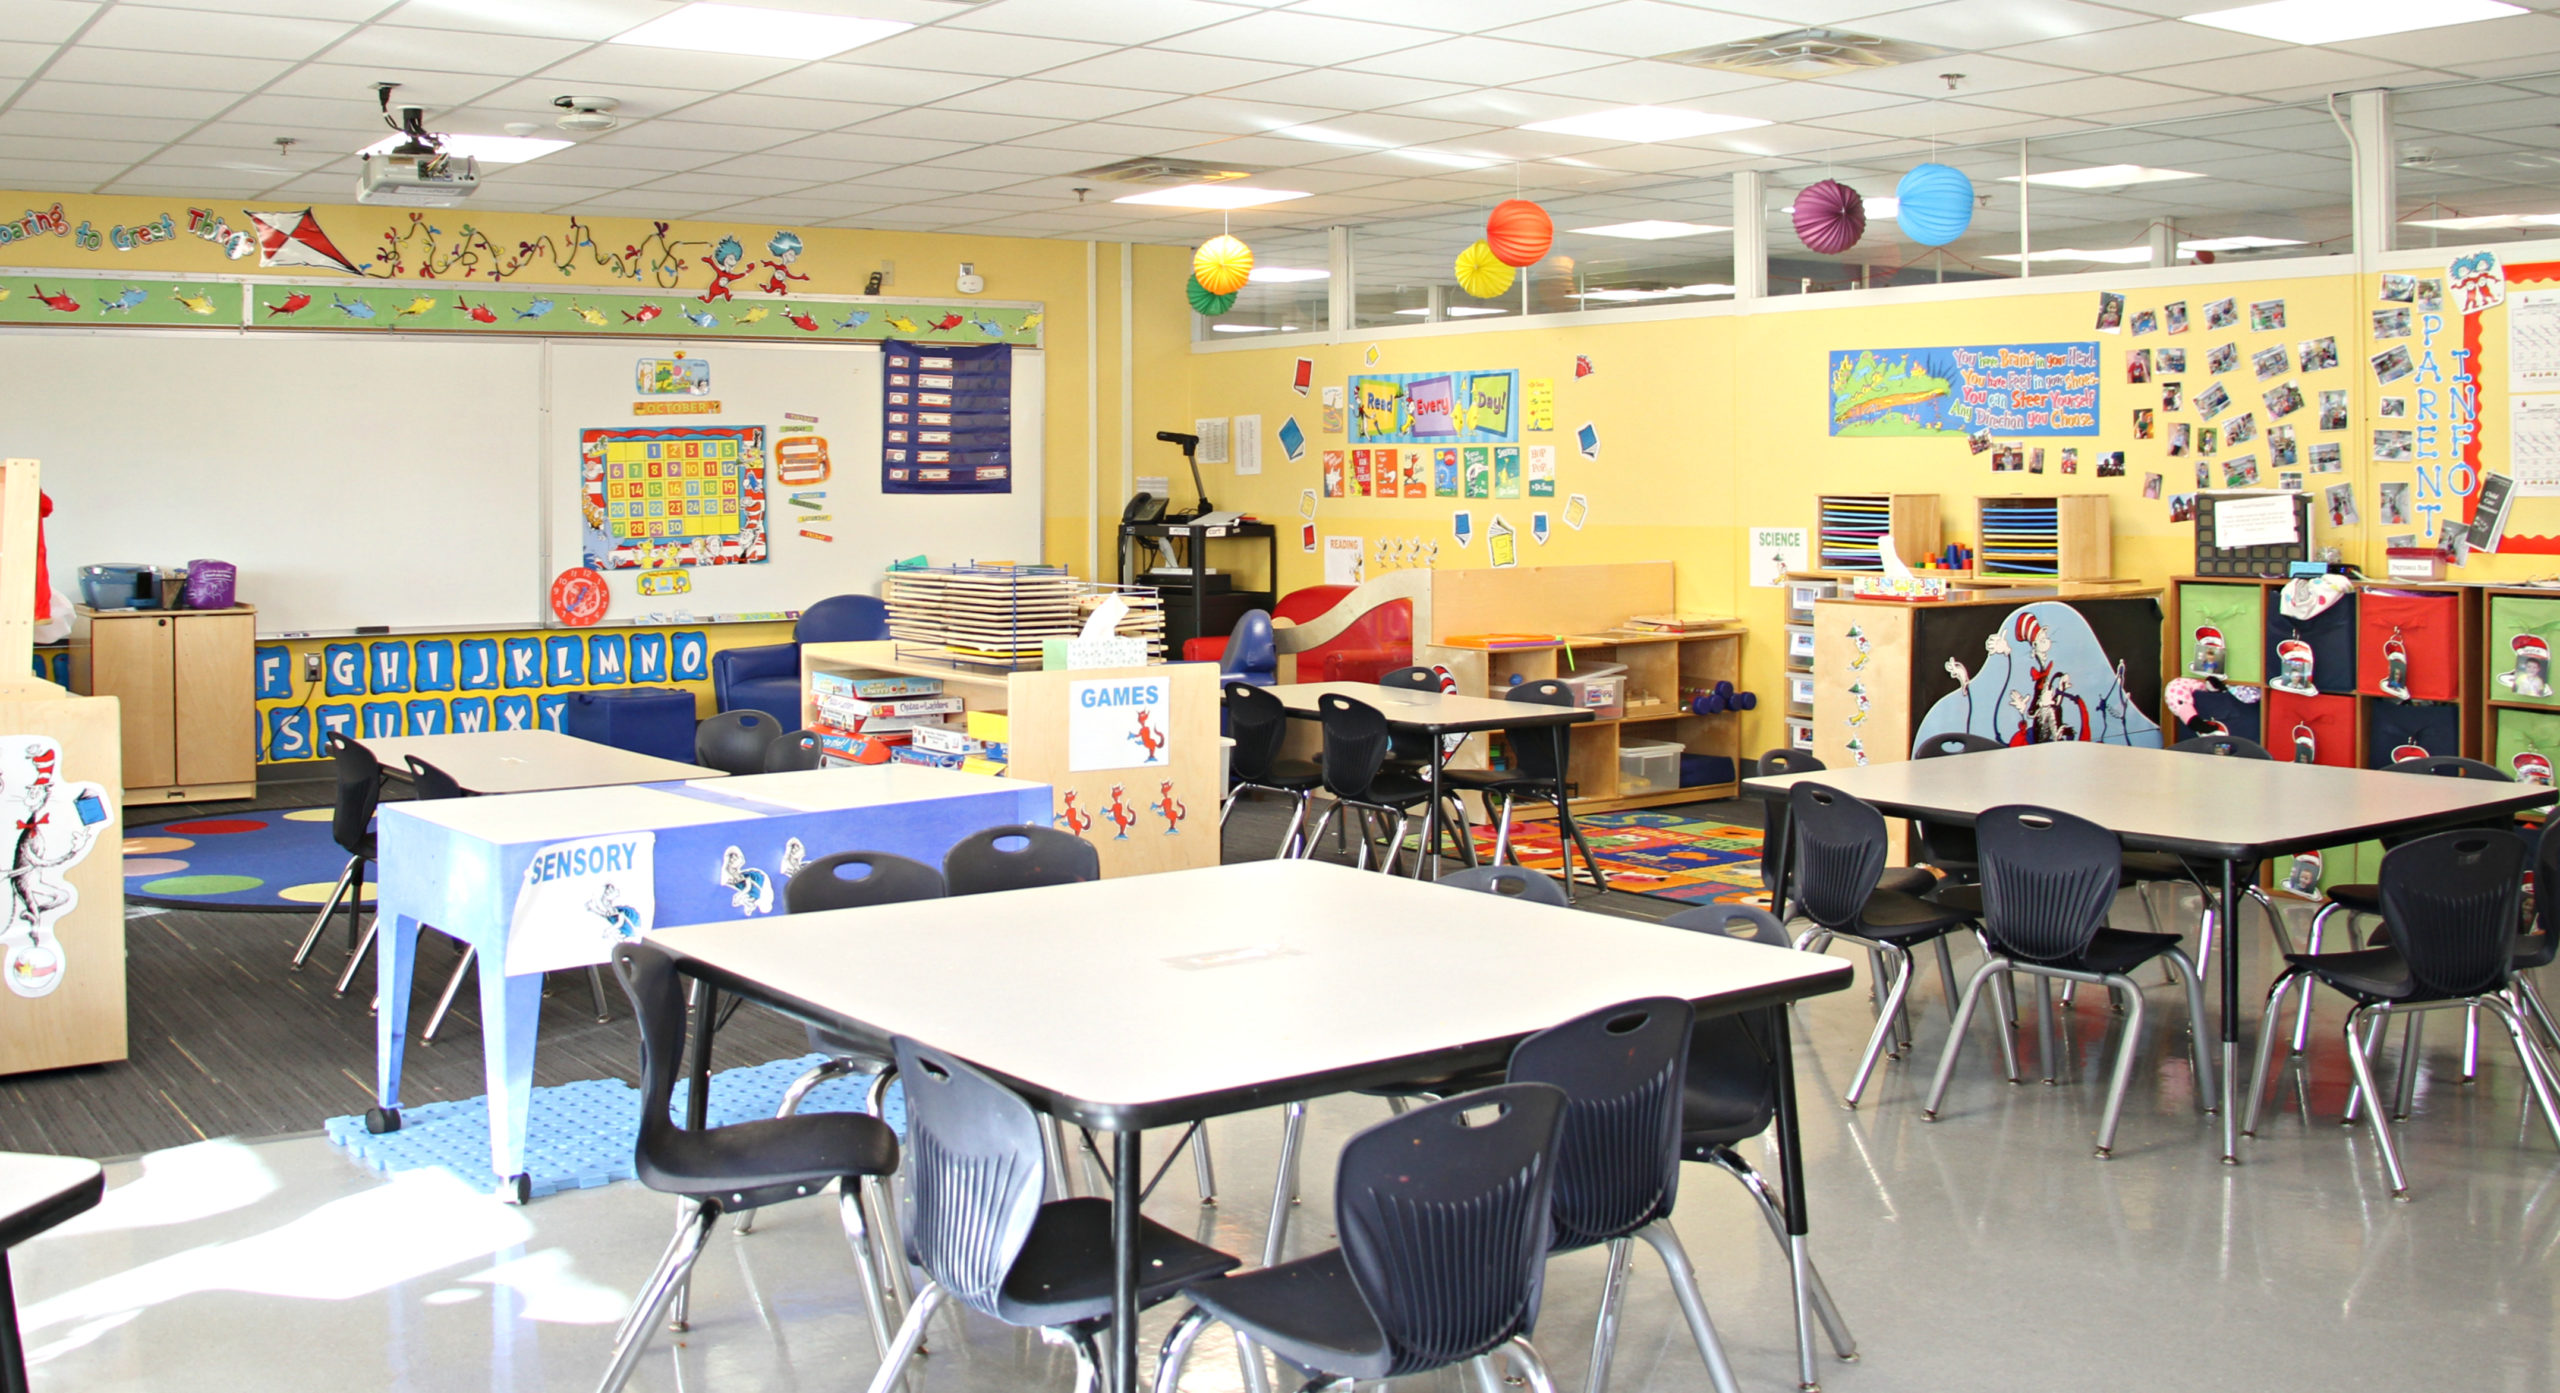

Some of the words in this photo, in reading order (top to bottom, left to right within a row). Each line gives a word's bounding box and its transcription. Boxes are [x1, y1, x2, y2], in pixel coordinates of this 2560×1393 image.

[0, 203, 70, 246] oaring
[76, 221, 102, 250] to
[1953, 349, 1976, 367] You
[1979, 352, 1999, 368] have
[1999, 348, 2035, 367] Brains
[2036, 355, 2045, 368] in
[2047, 353, 2066, 368] your
[1961, 368, 1986, 387] You
[1987, 371, 2006, 389] have
[2008, 369, 2032, 389] Feet
[2034, 374, 2044, 389] in
[2045, 374, 2064, 389] your
[648, 403, 706, 413] OCTOBER
[1367, 393, 1392, 412] Read
[1417, 397, 1449, 415] Every
[1478, 392, 1506, 415] Day!
[1962, 385, 1987, 404] You
[1988, 393, 2007, 409] can
[2011, 390, 2048, 408] Steer
[2049, 387, 2095, 408] Yourself
[1949, 398, 1972, 423] Any
[1975, 408, 2024, 429] Direction
[2027, 411, 2048, 428] you
[2448, 350, 2476, 495] INFO
[2415, 315, 2443, 536] PARENT
[652, 447, 656, 456] 1
[671, 446, 677, 455] 2
[689, 445, 694, 454] 3
[707, 445, 713, 454] 4
[725, 445, 731, 454] 5
[613, 467, 620, 476] 6
[633, 466, 639, 475] 7
[651, 465, 658, 475] 8
[671, 464, 678, 474] 9
[686, 465, 697, 474] 10
[706, 464, 715, 474] 11
[723, 464, 734, 473] 12
[612, 487, 623, 495] 13
[631, 485, 642, 495] 14
[650, 485, 661, 494] 15
[669, 484, 680, 493] 16
[688, 484, 697, 493] 17
[705, 483, 715, 492] 18
[723, 482, 734, 492] 19
[612, 505, 623, 514] 20
[632, 504, 641, 513] 21
[650, 504, 661, 513] 22
[669, 503, 680, 512] 23
[688, 502, 699, 511] 24
[705, 502, 716, 511] 25
[724, 501, 735, 511] 26
[613, 524, 623, 534] 27
[632, 523, 643, 533] 28
[650, 523, 661, 533] 29
[669, 521, 680, 531] 30
[1330, 539, 1358, 550] READING
[1759, 532, 1800, 547] SCIENCE
[263, 657, 280, 692] F
[332, 651, 355, 686] G
[380, 651, 399, 687] H
[428, 651, 438, 682] I
[472, 648, 489, 683] J
[512, 647, 533, 682] K
[557, 647, 572, 679] L
[599, 642, 620, 675] M
[641, 642, 659, 674] N
[682, 641, 701, 673] O
[1081, 685, 1159, 708] GAMES
[281, 715, 304, 751] S
[374, 712, 394, 738] U
[416, 710, 436, 735] V
[460, 706, 483, 732] W
[504, 705, 526, 730] X
[546, 703, 565, 733] Y
[531, 842, 637, 885] SENSORY
